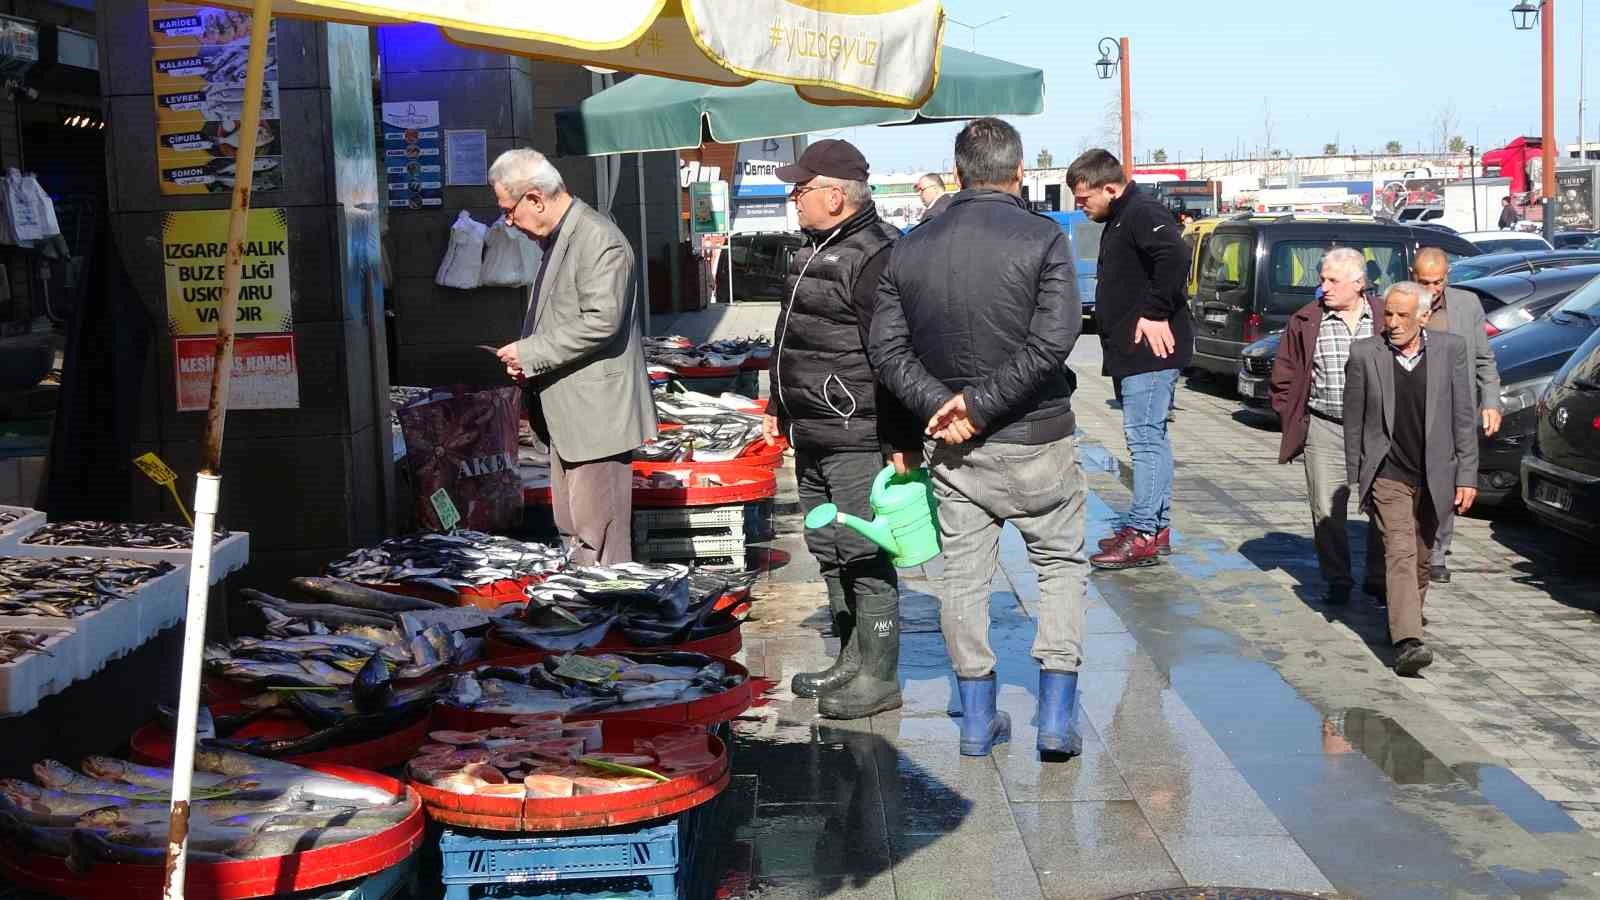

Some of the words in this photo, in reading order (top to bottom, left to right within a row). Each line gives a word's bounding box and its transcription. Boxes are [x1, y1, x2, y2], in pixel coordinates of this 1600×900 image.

[769, 15, 878, 70] #yüzdeyüz
[159, 58, 201, 70] KALAMAR
[165, 94, 200, 104] LEVREK
[171, 168, 203, 178] SOMON
[240, 240, 285, 257] ALIK
[178, 265, 215, 281] BUZ
[196, 306, 262, 322] VADIR
